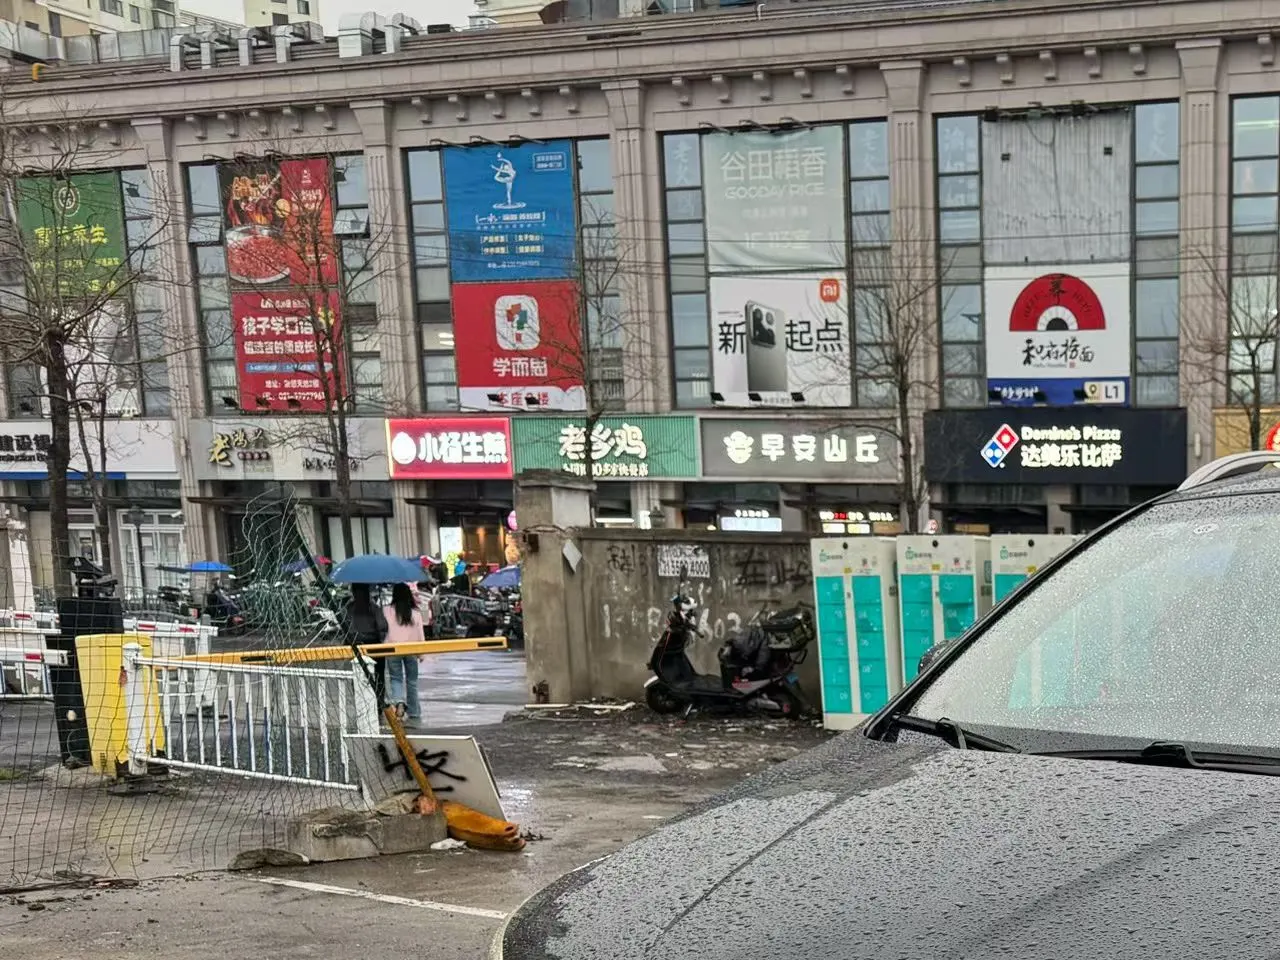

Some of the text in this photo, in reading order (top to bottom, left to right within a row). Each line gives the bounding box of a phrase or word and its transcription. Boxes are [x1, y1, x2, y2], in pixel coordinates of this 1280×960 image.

[789, 182, 825, 197] RICE
[785, 318, 843, 352] 起点
[1022, 335, 1095, 366] 和府捞面
[493, 356, 548, 377] 学而思
[1104, 385, 1119, 399] L1
[558, 423, 647, 460] 老乡鸡
[1021, 425, 1121, 440] Domino's Pizza
[418, 431, 509, 464] 小杨生煎
[761, 434, 880, 463] 早安山丘
[1021, 443, 1122, 467] 达美乐比萨
